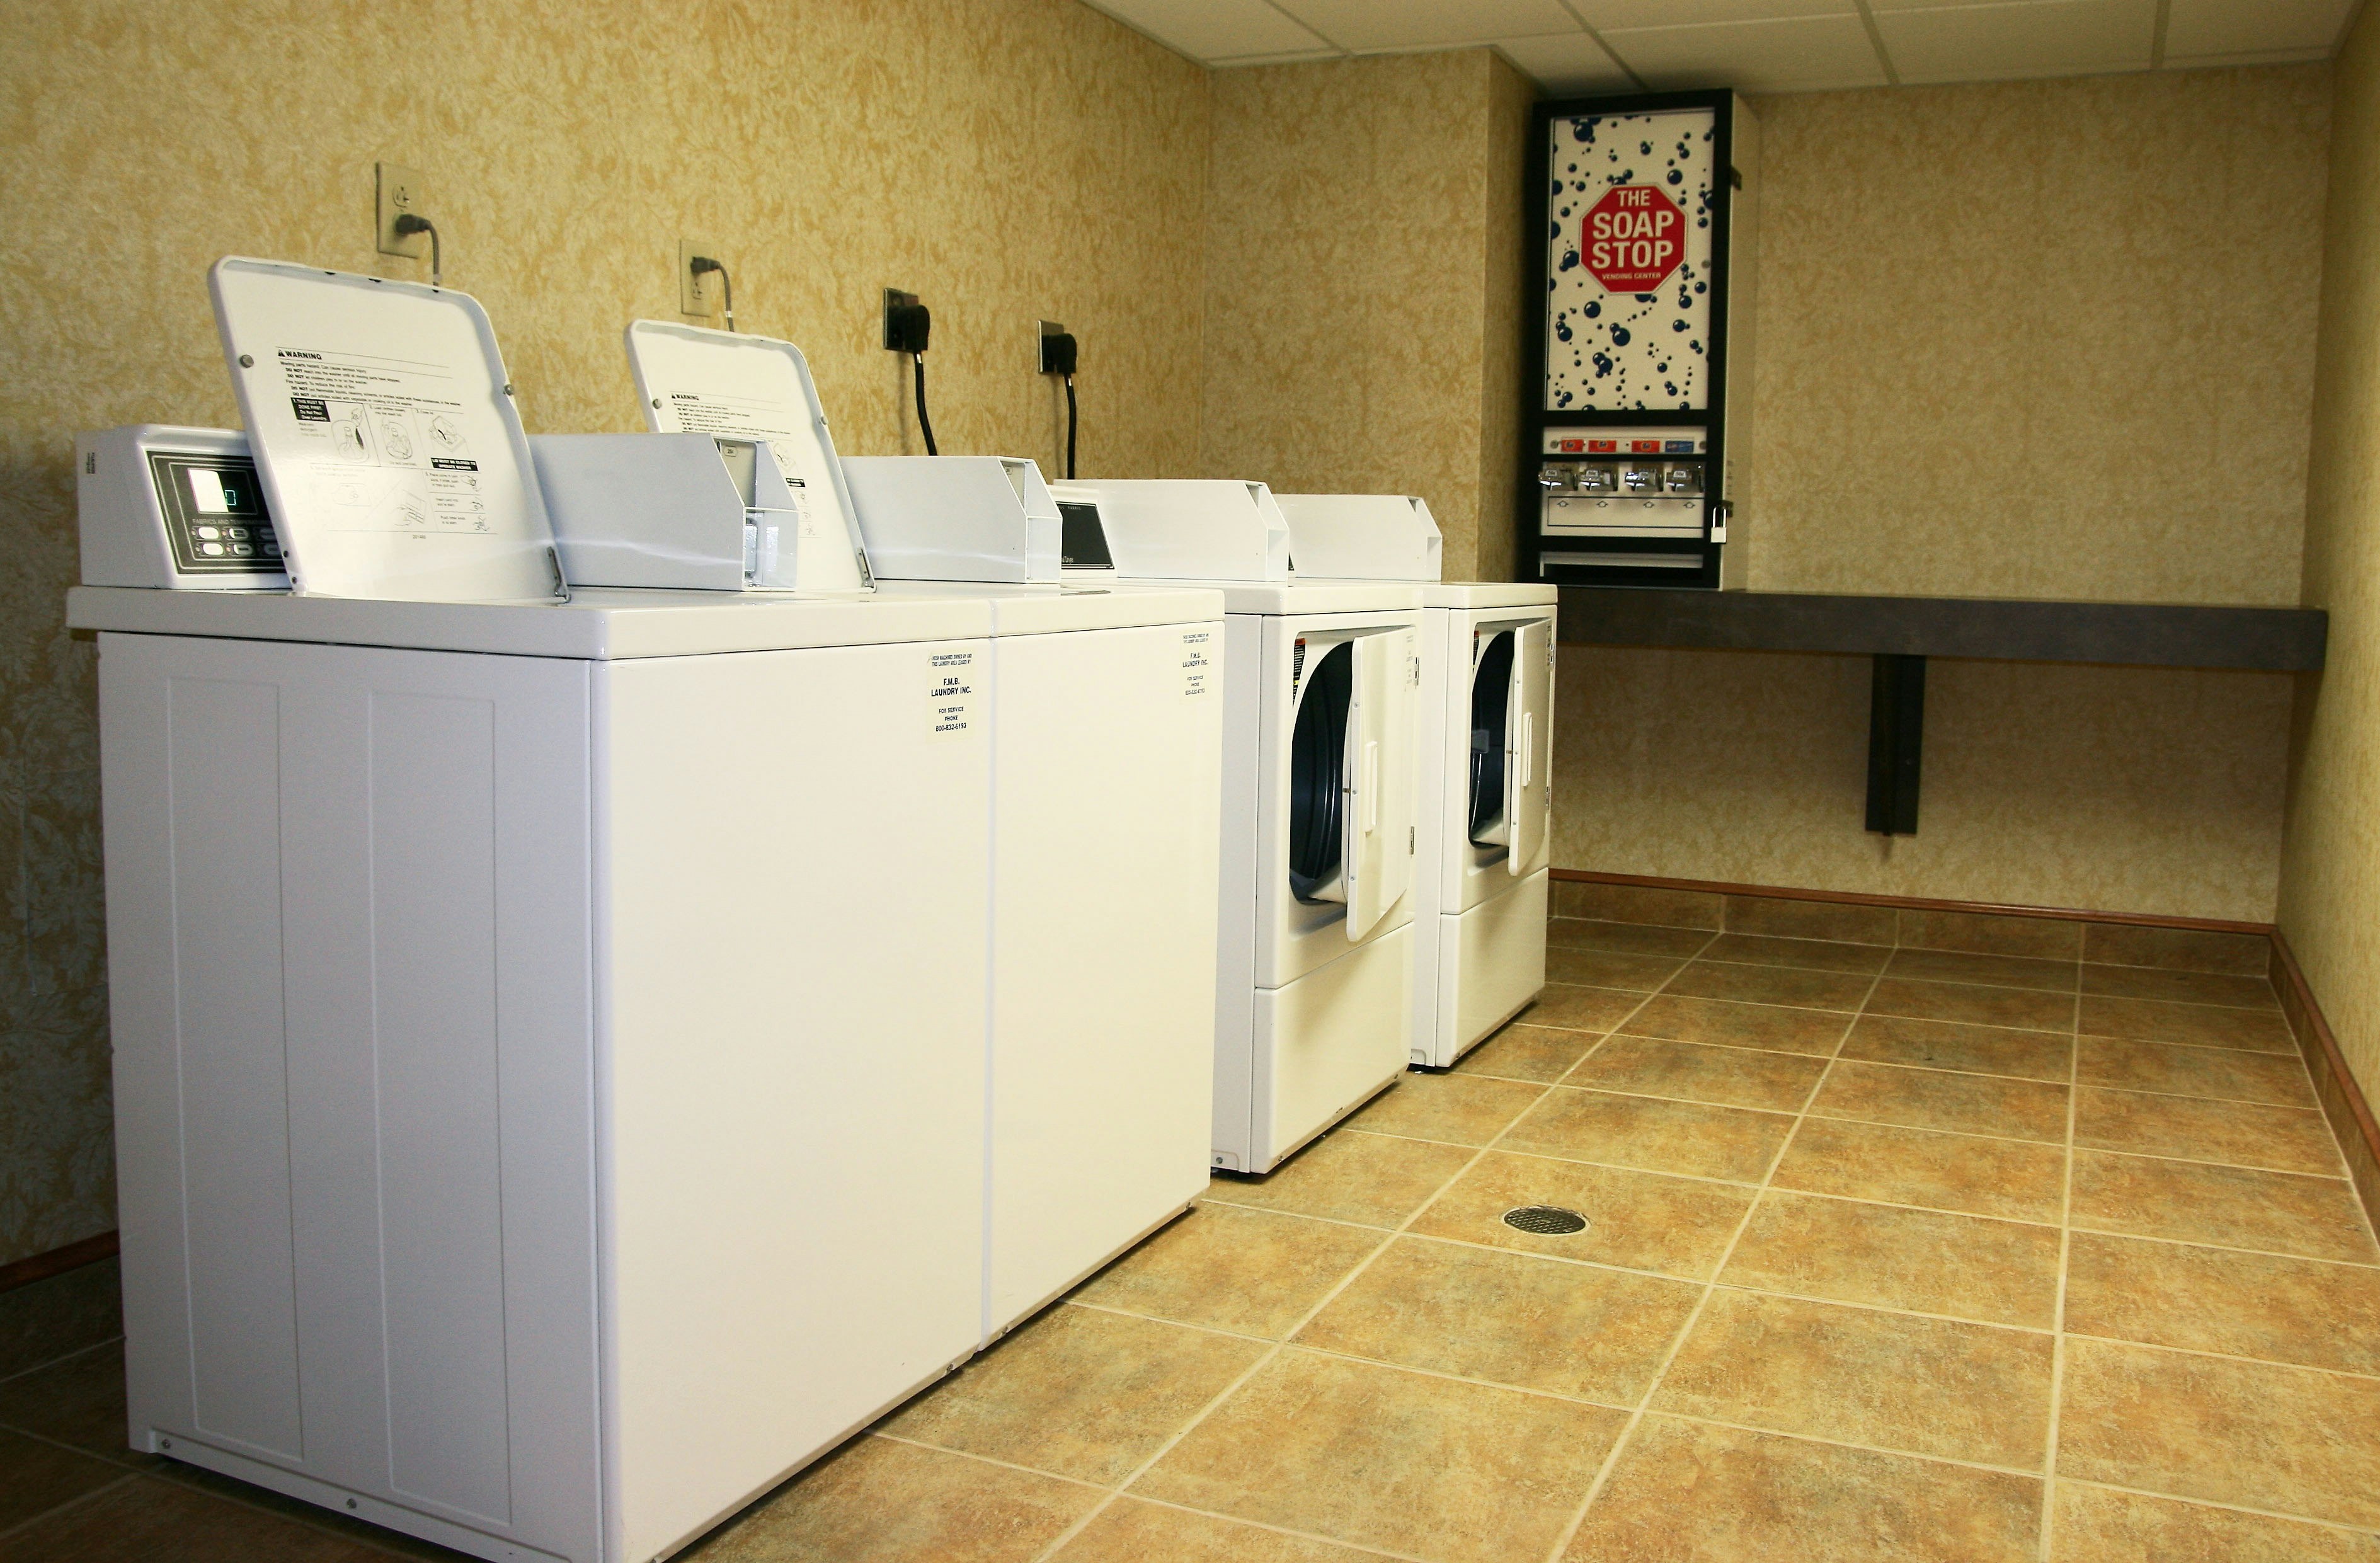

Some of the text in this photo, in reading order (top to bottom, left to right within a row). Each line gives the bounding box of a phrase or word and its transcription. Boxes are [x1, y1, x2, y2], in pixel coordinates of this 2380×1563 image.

[1617, 190, 1651, 207] THE
[1593, 210, 1674, 239] SOAP
[1591, 240, 1673, 269] STOP
[285, 350, 322, 360] WARNING
[943, 677, 960, 685] F.M.B.
[931, 686, 971, 697] LAUNDRY INC.
